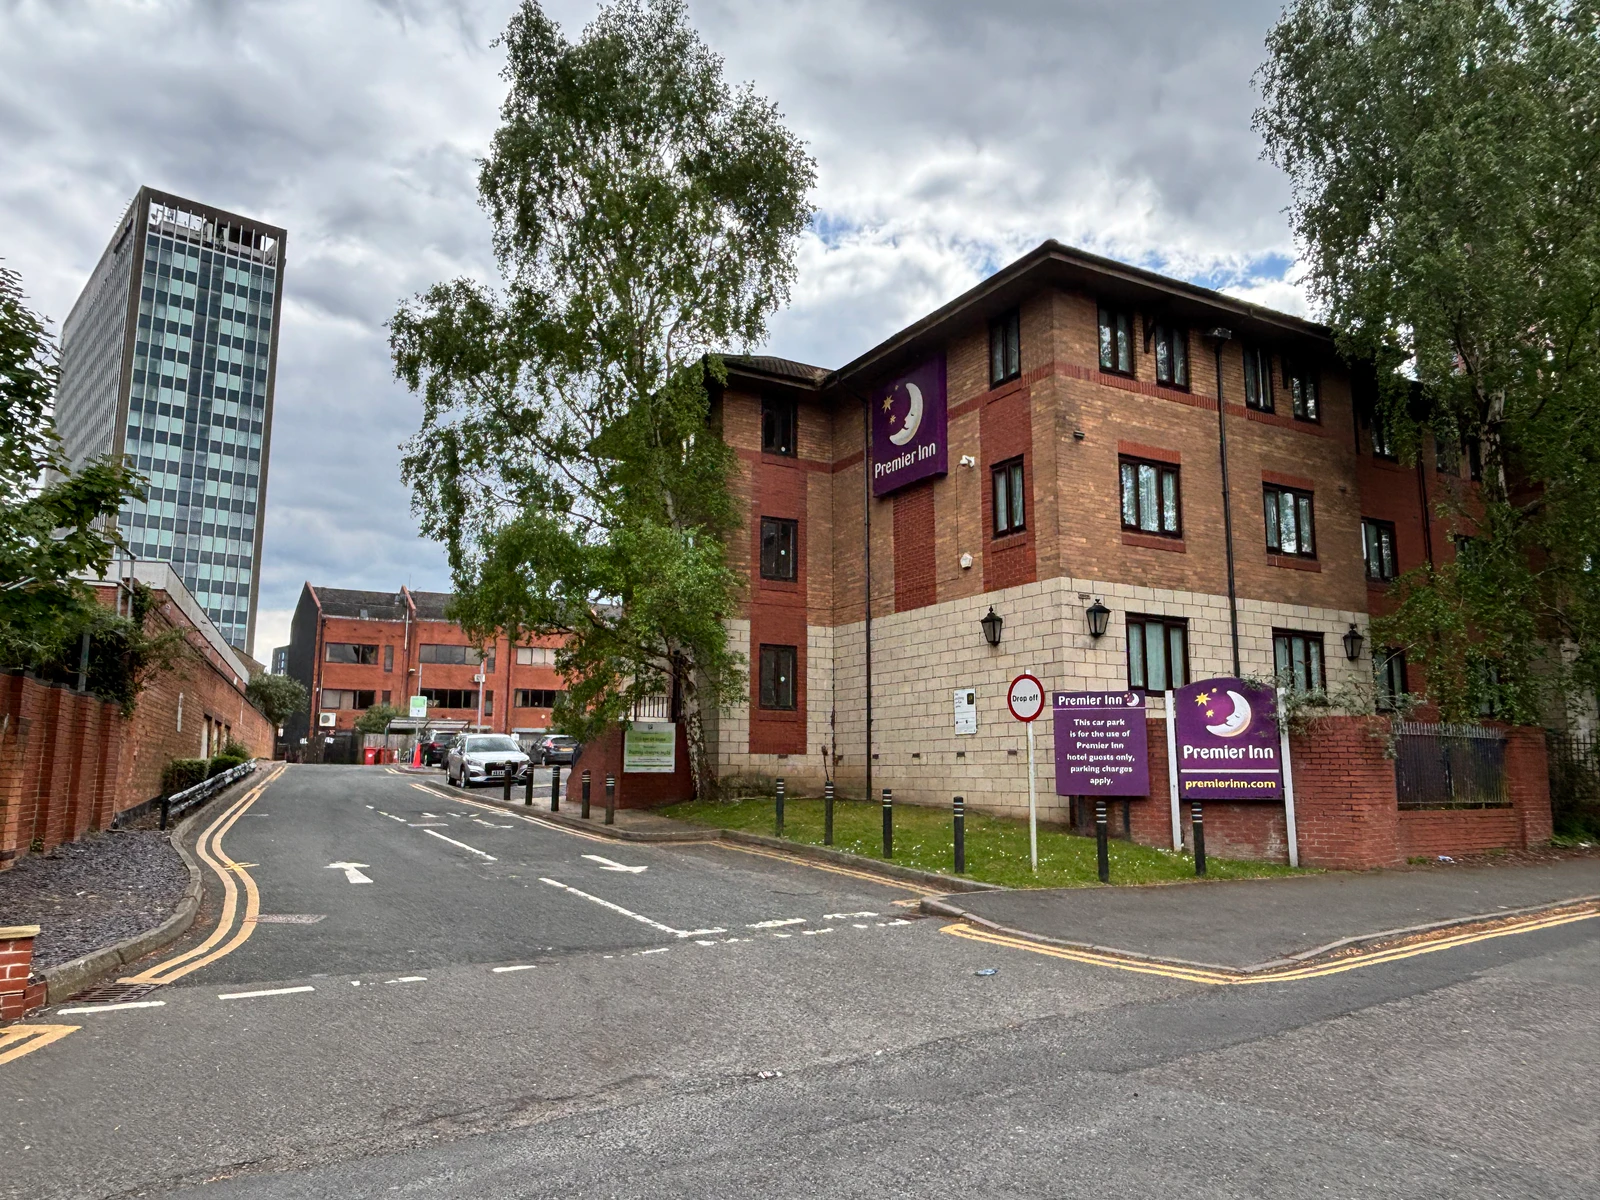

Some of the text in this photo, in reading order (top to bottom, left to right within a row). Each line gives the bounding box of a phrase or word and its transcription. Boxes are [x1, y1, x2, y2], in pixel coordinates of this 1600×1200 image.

[875, 442, 936, 479] Premier Inn
[1058, 695, 1122, 706] Premier Inn
[1106, 718, 1125, 727] park
[1183, 745, 1274, 759] Premier Inn
[1116, 754, 1135, 762] only,
[1070, 765, 1132, 774] parking charges
[1090, 777, 1113, 785] apply.
[1185, 779, 1276, 790] premierinn.com
